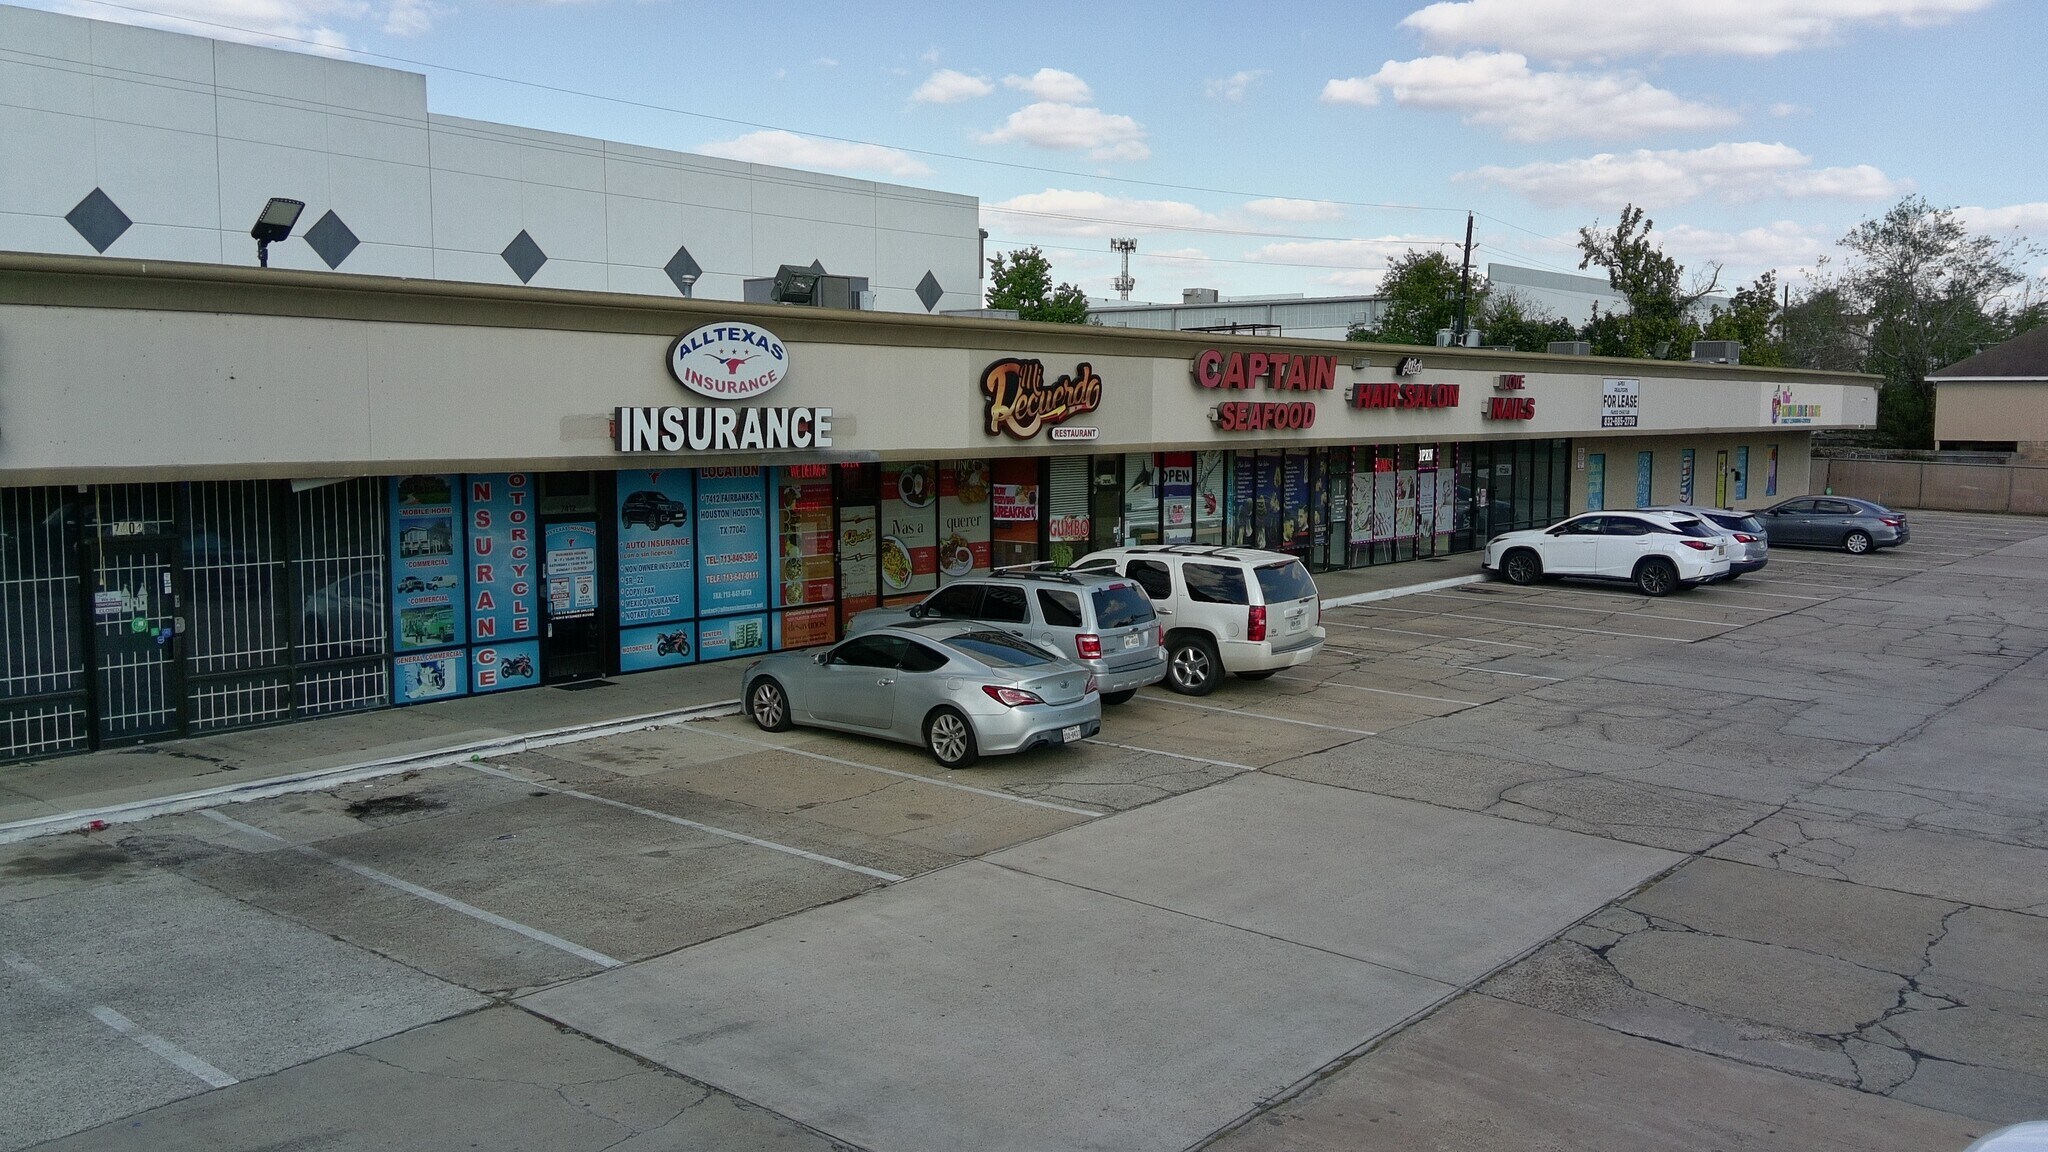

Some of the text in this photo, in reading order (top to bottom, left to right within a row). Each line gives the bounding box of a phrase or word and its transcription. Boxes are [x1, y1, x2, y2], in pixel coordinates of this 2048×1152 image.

[680, 327, 783, 361] ALLTEXAS
[1197, 349, 1338, 390] CAPTAIN
[684, 367, 778, 394] INSURANCE
[1503, 374, 1526, 390] LOVE
[1355, 383, 1459, 409] HAIR SALON
[1603, 394, 1638, 408] FOR LEASE
[1489, 397, 1536, 420] NAILS
[1221, 402, 1316, 431] SEAFOOD
[616, 406, 833, 452] INSURANCE
[1054, 429, 1097, 438] RESTAURANT
[701, 465, 759, 478] LOCATION
[1161, 469, 1190, 482] OPEN
[706, 494, 720, 504] 7412
[721, 493, 754, 502] FAIRBANKS
[402, 508, 429, 516] MOBILE
[561, 504, 576, 512] 7412
[700, 509, 729, 520] HOUSTON
[993, 505, 1036, 519] BREAKFAST
[568, 525, 596, 536] INSURANCE
[719, 525, 746, 535] TX 77040
[917, 522, 924, 533] a
[946, 516, 982, 532] querer
[1050, 519, 1090, 537] GUMBO
[626, 538, 690, 550] AUTO INSURANCE
[408, 559, 449, 568] COMMERCIAL
[624, 560, 690, 573] NON OWNER INSURANCE
[625, 577, 633, 585] SR
[637, 576, 644, 584] 22
[644, 586, 655, 595] FAX
[410, 595, 449, 604] COMMERCIAL
[625, 595, 680, 608] MEXICO INSURANCE
[625, 607, 671, 620] NOTARY PUBLIC
[622, 644, 653, 653] MOTORCYCLE
[702, 638, 727, 648] INSURANCE
[396, 650, 463, 664] GENERAL COMMERCIAL
